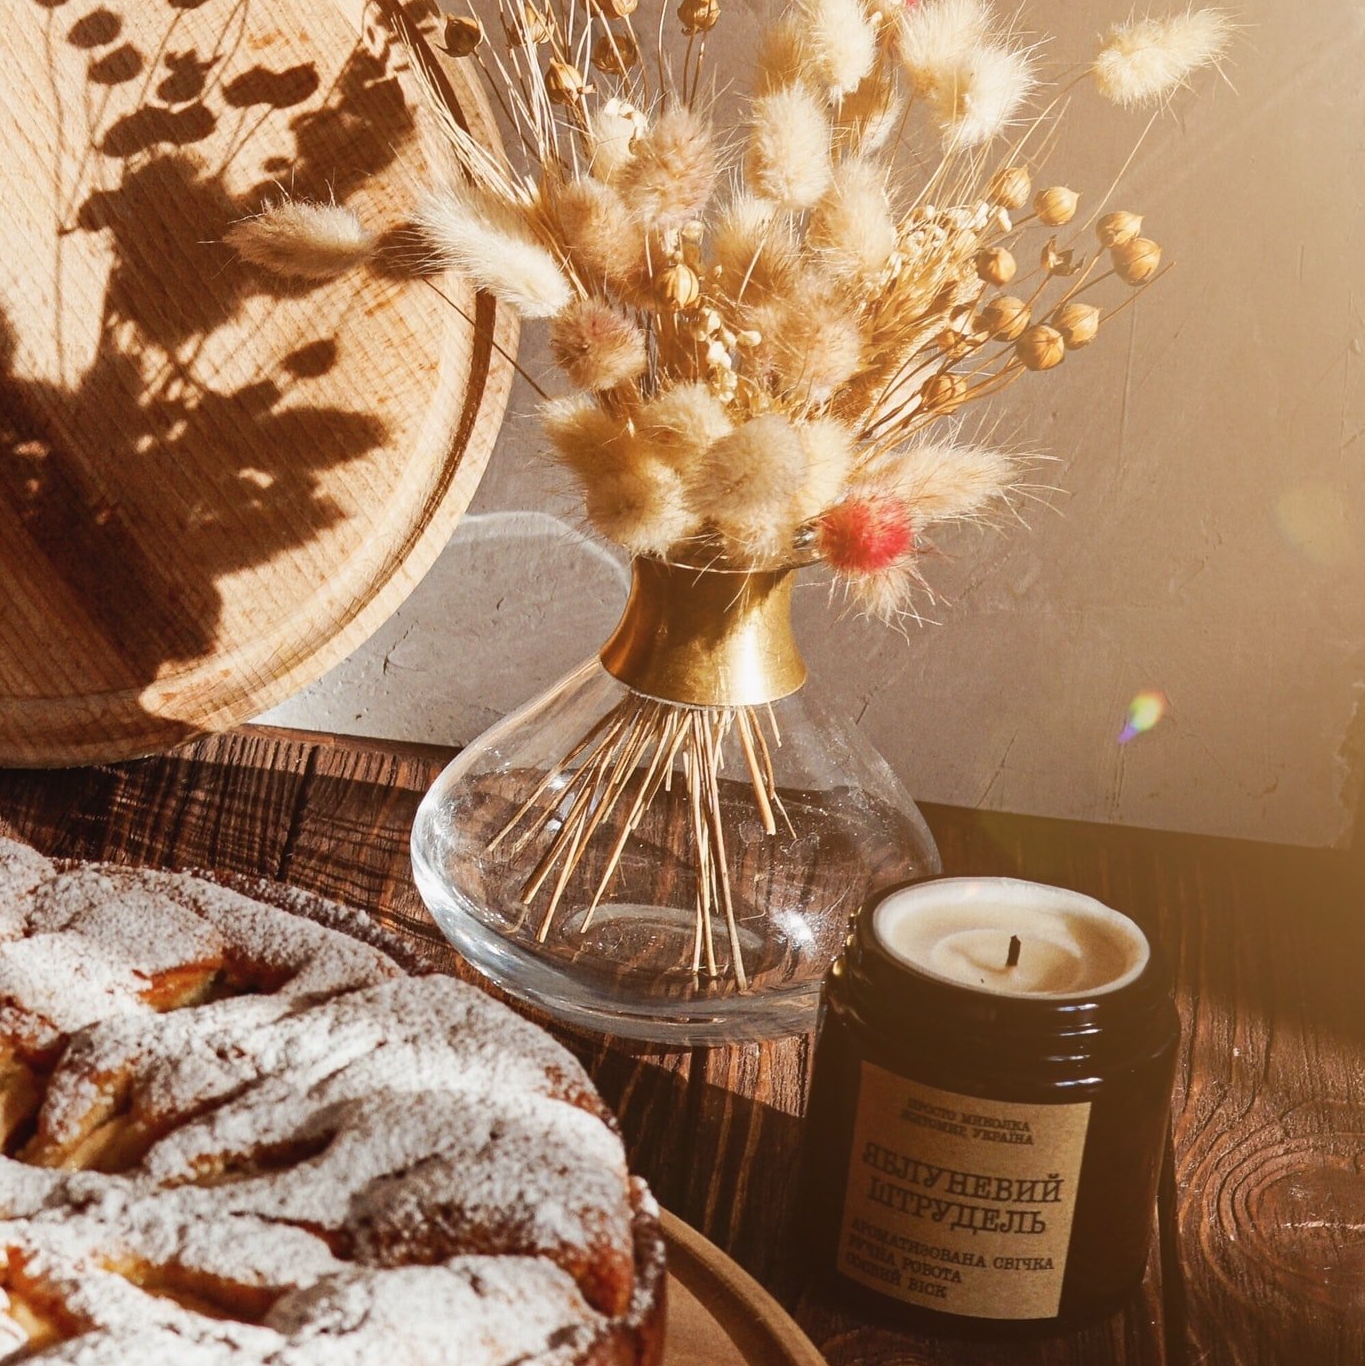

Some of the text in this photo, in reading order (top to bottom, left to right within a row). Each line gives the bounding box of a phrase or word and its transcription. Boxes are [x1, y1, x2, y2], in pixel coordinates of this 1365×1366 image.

[972, 1128, 1035, 1145] УКРАЇНА
[862, 1143, 1065, 1203] ЯБЛУНЕВИЙ
[868, 1176, 1046, 1235] ШТРУДЕЛЬ
[849, 1234, 963, 1283] РУЧНА РОБОТА
[851, 1217, 1054, 1270] АРОМАТИЗОВАНА СВІЧКА
[908, 1278, 947, 1298] ВІСК
